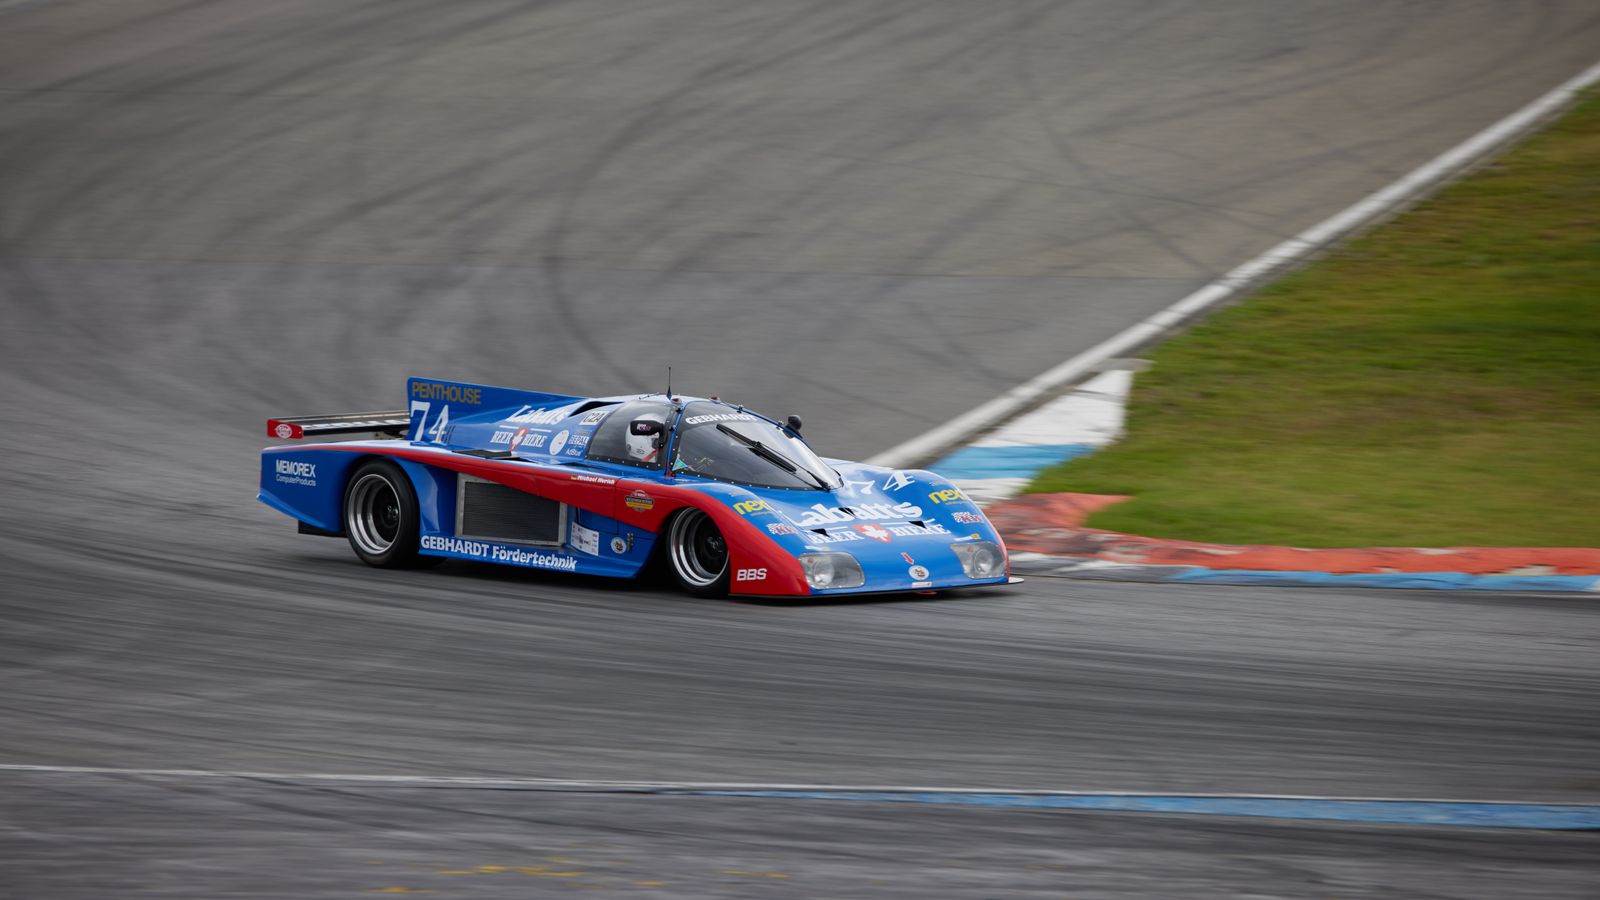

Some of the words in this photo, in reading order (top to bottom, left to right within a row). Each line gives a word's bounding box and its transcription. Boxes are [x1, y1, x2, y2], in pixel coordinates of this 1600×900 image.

[411, 381, 481, 405] PENTHOUSE
[410, 400, 449, 444] 74
[685, 413, 757, 425] GEBHARDT
[490, 431, 513, 444] BEER
[276, 460, 316, 477] MEMOREX
[420, 535, 490, 557] GEBHARDT
[492, 546, 577, 570] Fördertechnik
[736, 568, 767, 581] BBS
